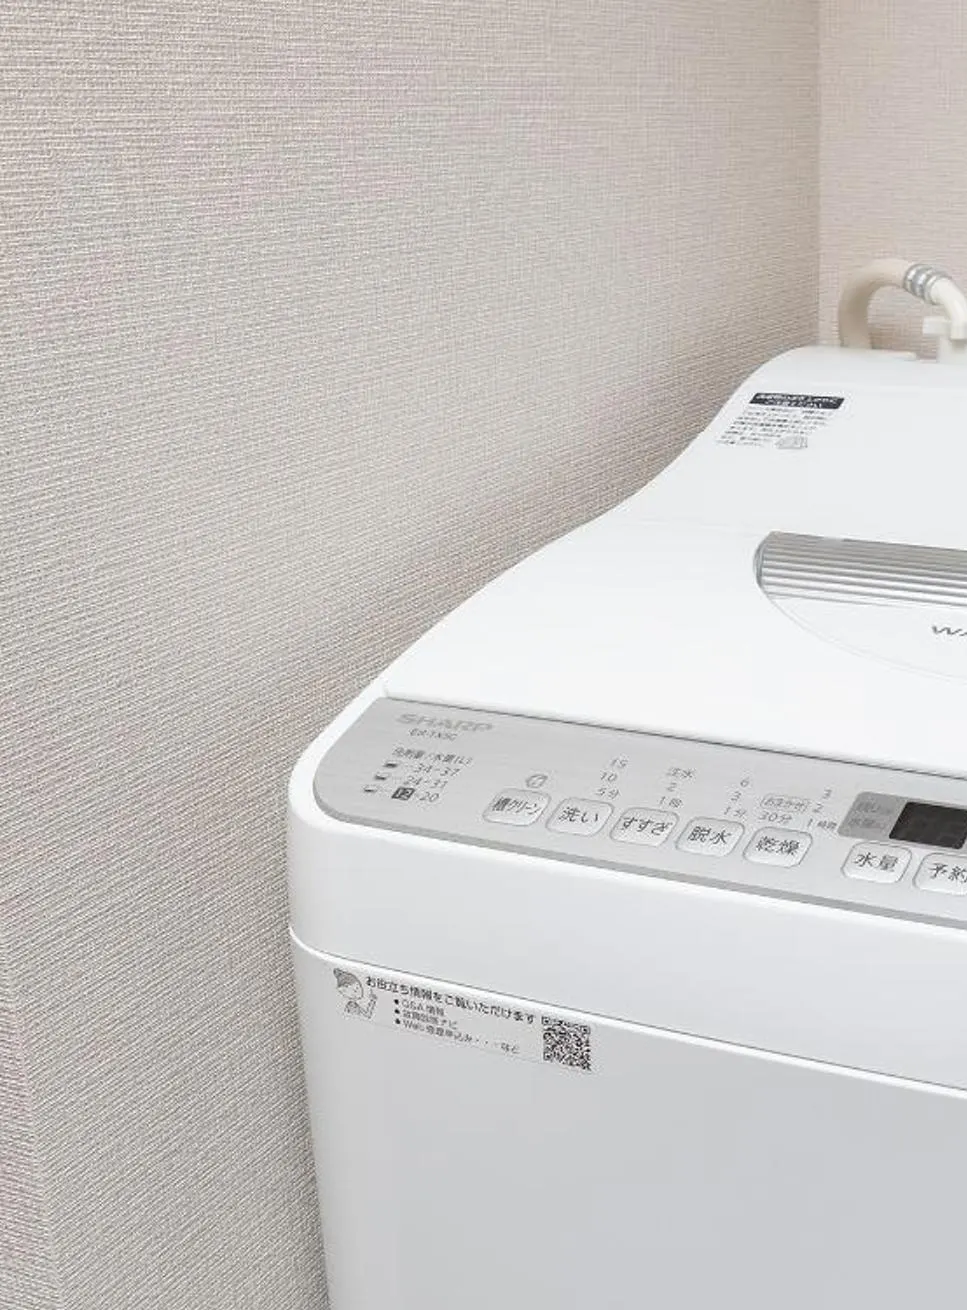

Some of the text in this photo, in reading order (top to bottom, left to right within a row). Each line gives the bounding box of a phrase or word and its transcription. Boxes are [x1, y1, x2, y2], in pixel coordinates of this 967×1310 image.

[396, 713, 494, 731] SHARP
[600, 771, 618, 782] 10
[559, 807, 599, 824] 洗い
[621, 817, 674, 836] すすぎ
[687, 826, 732, 844] 脱水
[756, 836, 800, 855] 乾燥
[855, 852, 899, 872] 水量
